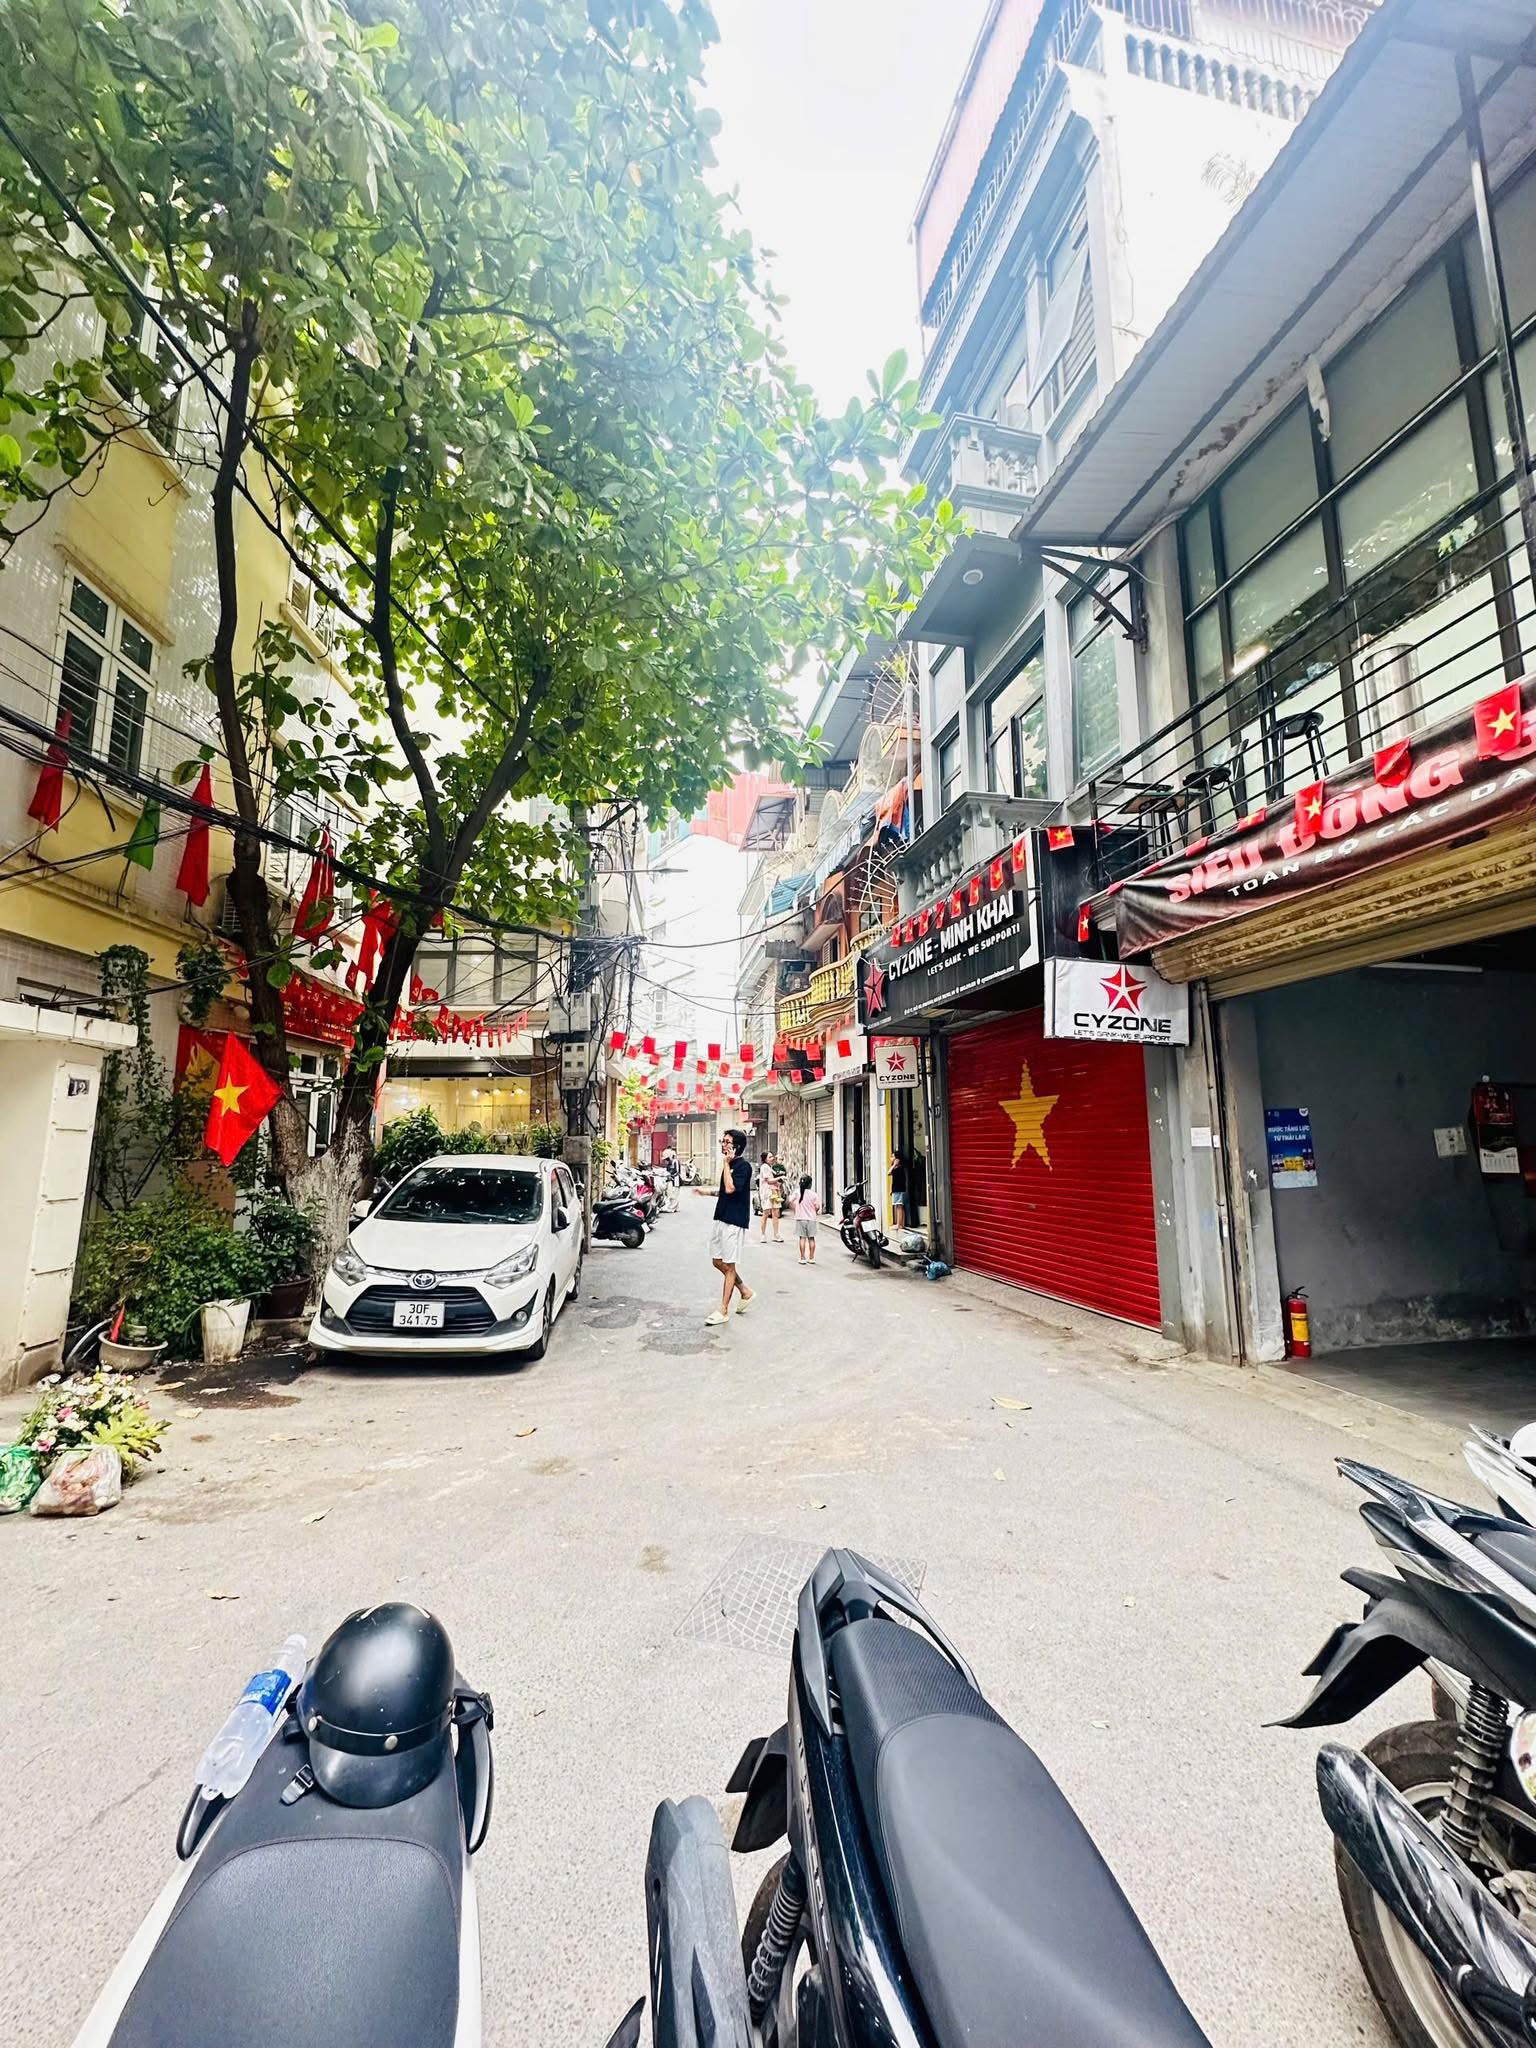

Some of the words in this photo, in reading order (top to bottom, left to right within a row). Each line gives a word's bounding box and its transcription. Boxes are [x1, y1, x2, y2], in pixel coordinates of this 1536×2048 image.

[1375, 801, 1450, 839] CÁC
[1164, 838, 1263, 904] SIÊU
[888, 936, 934, 981] CYZONE
[940, 913, 975, 954] MINH
[976, 890, 1015, 934] KHAI
[927, 961, 944, 977] LET'S
[968, 943, 980, 957] WE
[1073, 1012, 1172, 1034] CYZONE
[1073, 1029, 1095, 1037] LET'S
[1133, 1033, 1171, 1041] SUPPORT
[879, 1073, 916, 1082] CYZONE
[409, 1303, 430, 1314] 30F
[399, 1315, 438, 1326] 341.75
